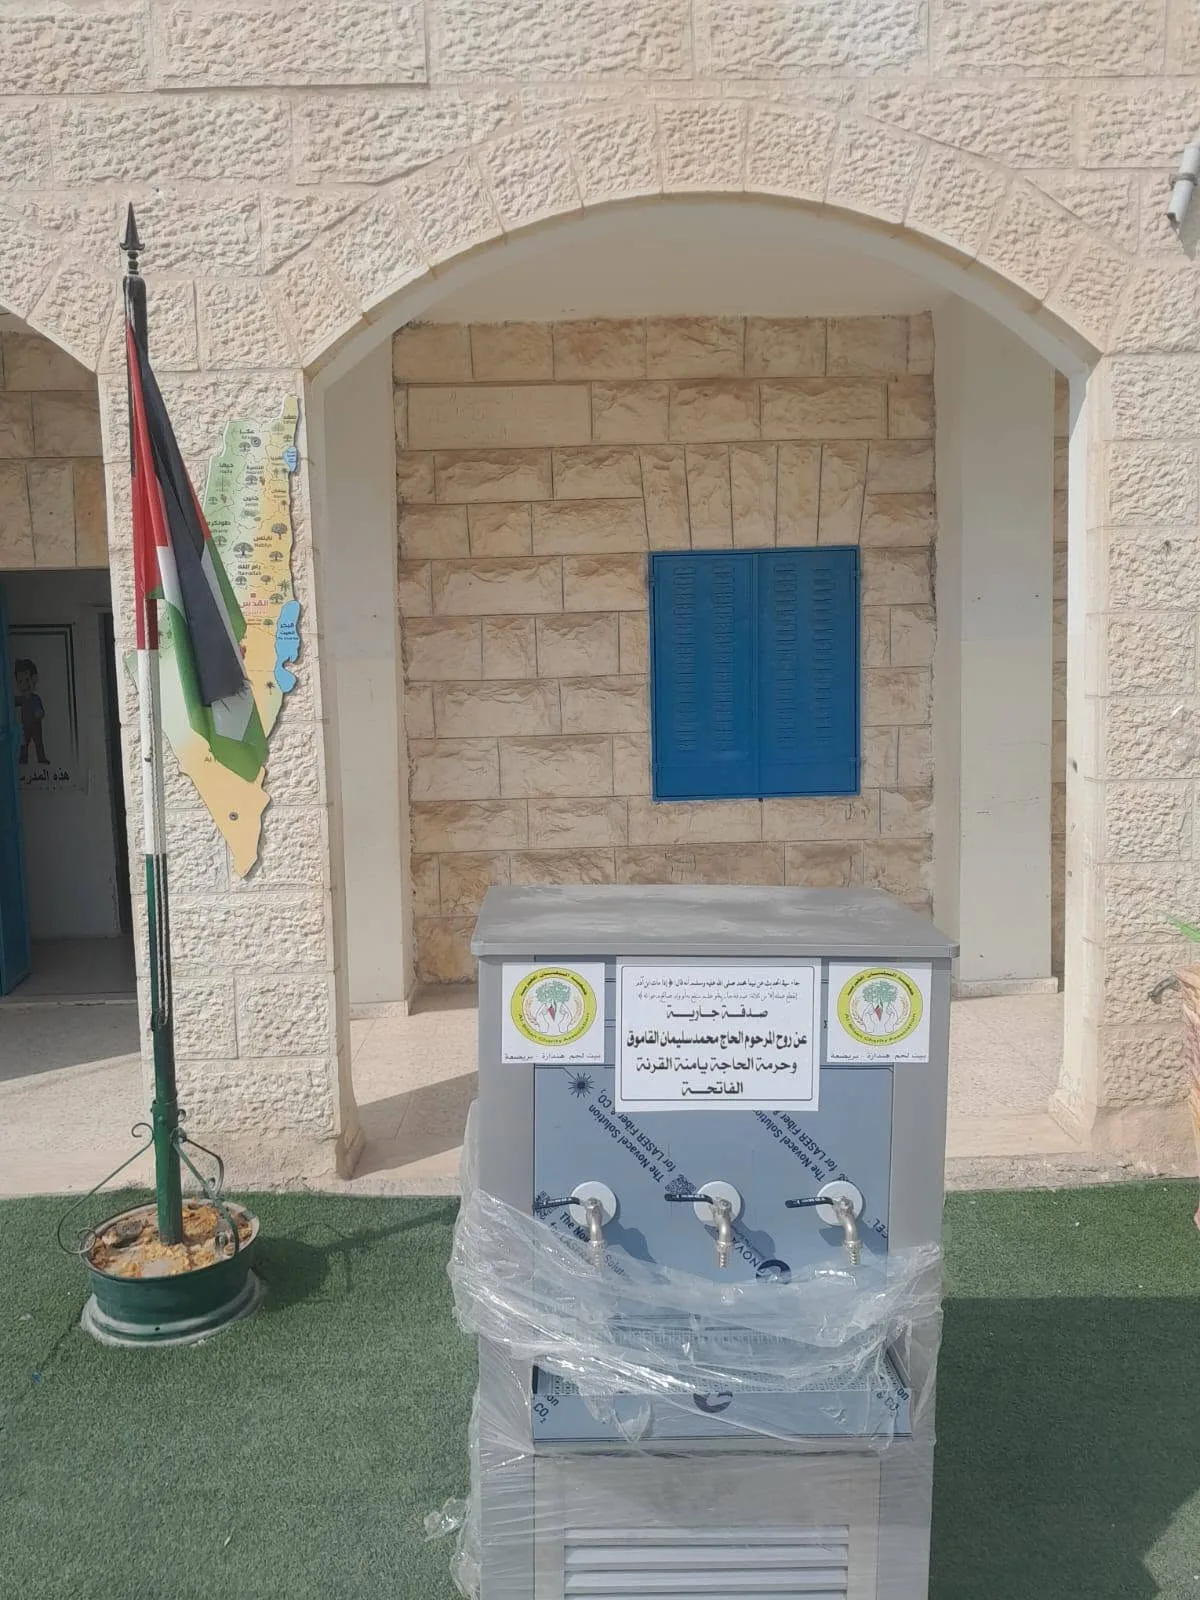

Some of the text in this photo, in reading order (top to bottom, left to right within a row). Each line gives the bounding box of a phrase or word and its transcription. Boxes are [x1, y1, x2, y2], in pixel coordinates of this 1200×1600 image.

[666, 1003, 769, 1022] صدقة جارية
[719, 1029, 745, 1050] الحاج
[744, 1030, 776, 1050] المرحوم
[776, 1032, 793, 1050] روح
[793, 1030, 808, 1050] عن
[681, 1080, 745, 1097] الفاتحة
[618, 1113, 640, 1137] Fiber
[780, 1113, 802, 1136] Fiber
[588, 1104, 665, 1183] The Novacel Solution
[636, 1132, 665, 1161] LASER
[752, 1109, 826, 1182] The Novacel Solutio
[798, 1132, 827, 1161] LASER
[662, 1158, 677, 1173] for
[823, 1158, 838, 1172] for
[560, 1211, 575, 1229] The
